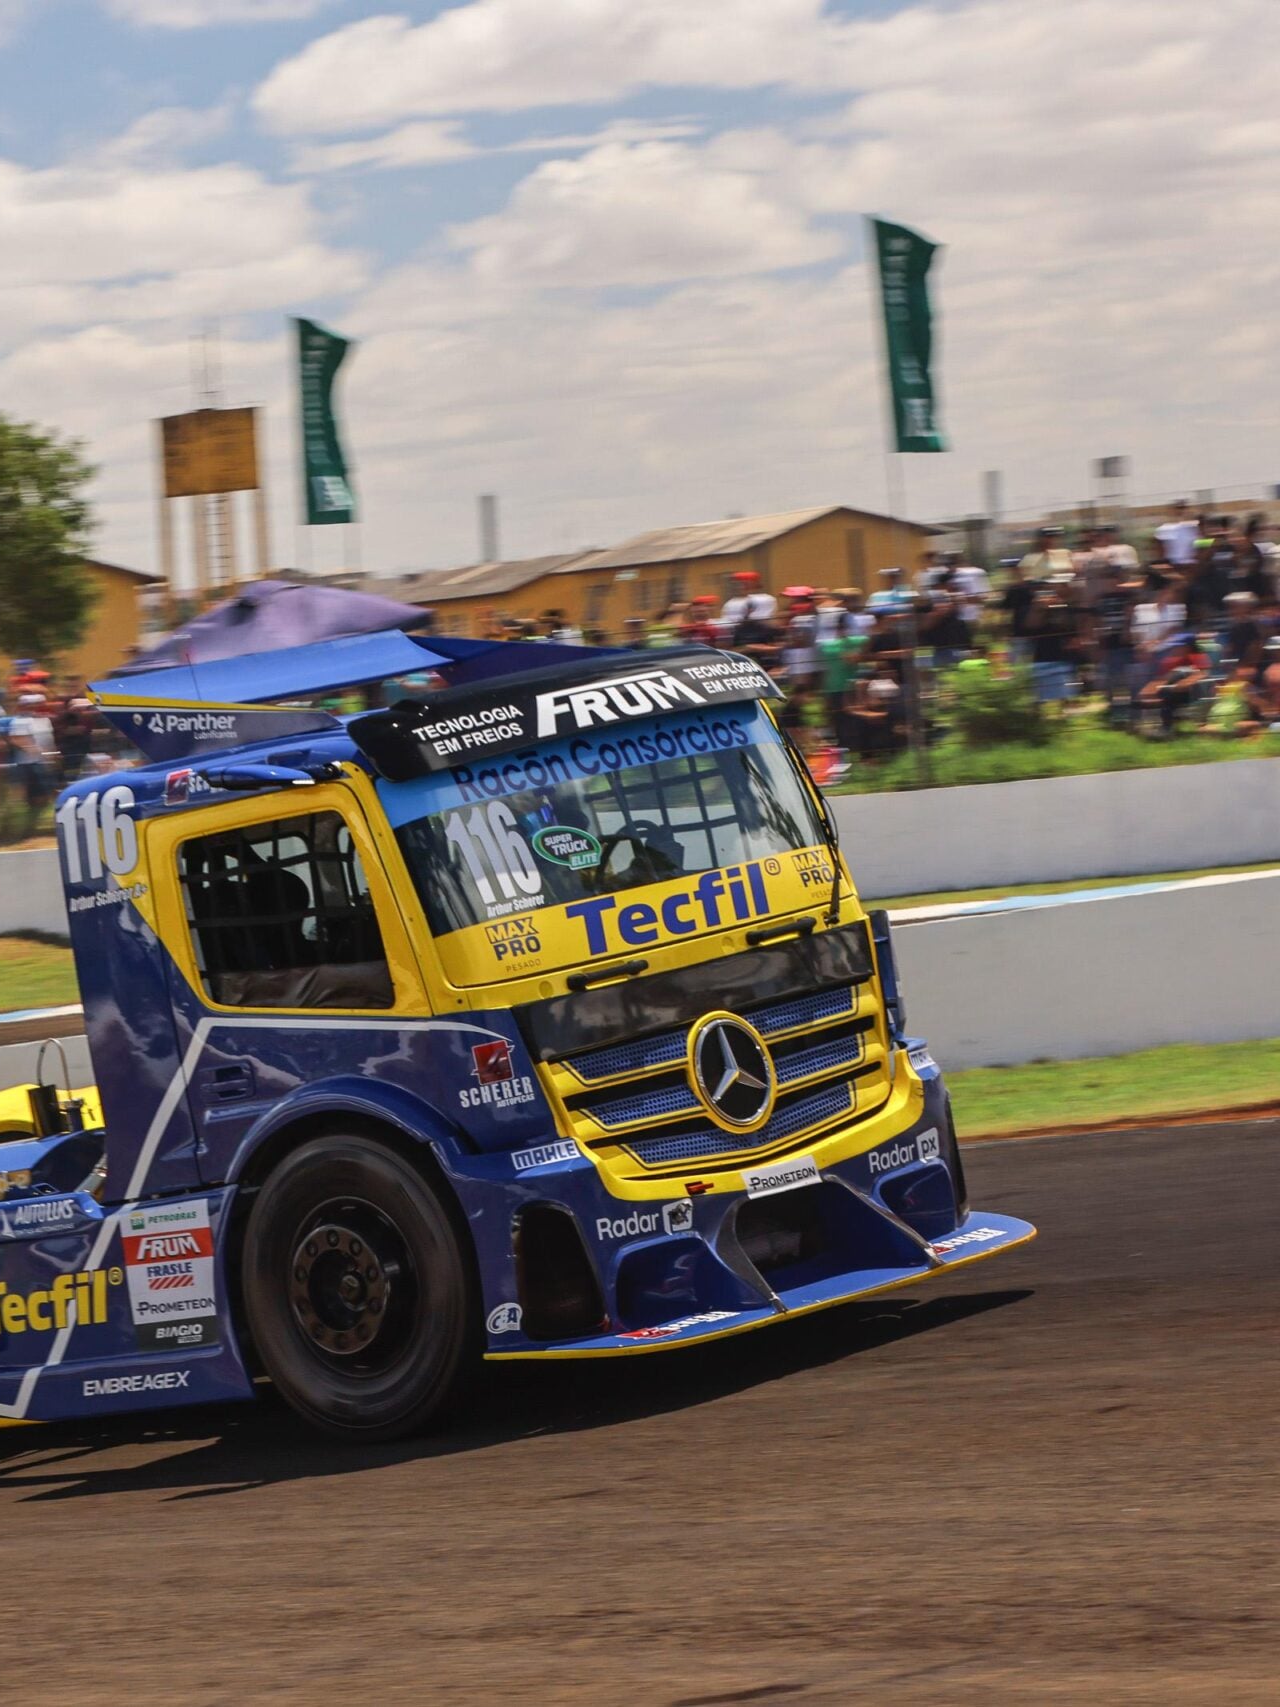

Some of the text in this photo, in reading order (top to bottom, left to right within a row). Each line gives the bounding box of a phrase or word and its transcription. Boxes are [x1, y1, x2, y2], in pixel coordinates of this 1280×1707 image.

[683, 661, 762, 680] TECNOLOGIA
[702, 675, 769, 694] EM FREIOS
[535, 670, 708, 738] FRUM
[166, 713, 236, 732] Panther
[411, 704, 524, 741] TECNOLOGIA
[432, 722, 524, 756] EM FREIOS
[570, 716, 749, 776] Consórcios
[56, 785, 139, 884] 116
[543, 832, 573, 847] SUPER
[551, 838, 589, 856] TRUCK
[444, 800, 543, 904] 116
[571, 852, 598, 867] ELITE
[791, 850, 829, 872] MAX
[800, 867, 835, 888] PRO
[486, 894, 545, 919] Arthur Scherer
[485, 916, 539, 945] MAX
[493, 936, 542, 961] PRO
[506, 959, 542, 973] PESADO
[459, 1076, 535, 1108] SCHERER
[514, 1142, 577, 1168] MAHLE
[868, 1136, 937, 1174] Radar px
[748, 1165, 817, 1191] PROMETEON
[148, 1211, 197, 1225] PETROBRAS
[596, 1211, 660, 1241] Radar
[136, 1232, 202, 1260] FRUM
[156, 1324, 203, 1339] BIAGIO
[83, 1370, 191, 1397] EMBREAGEX
